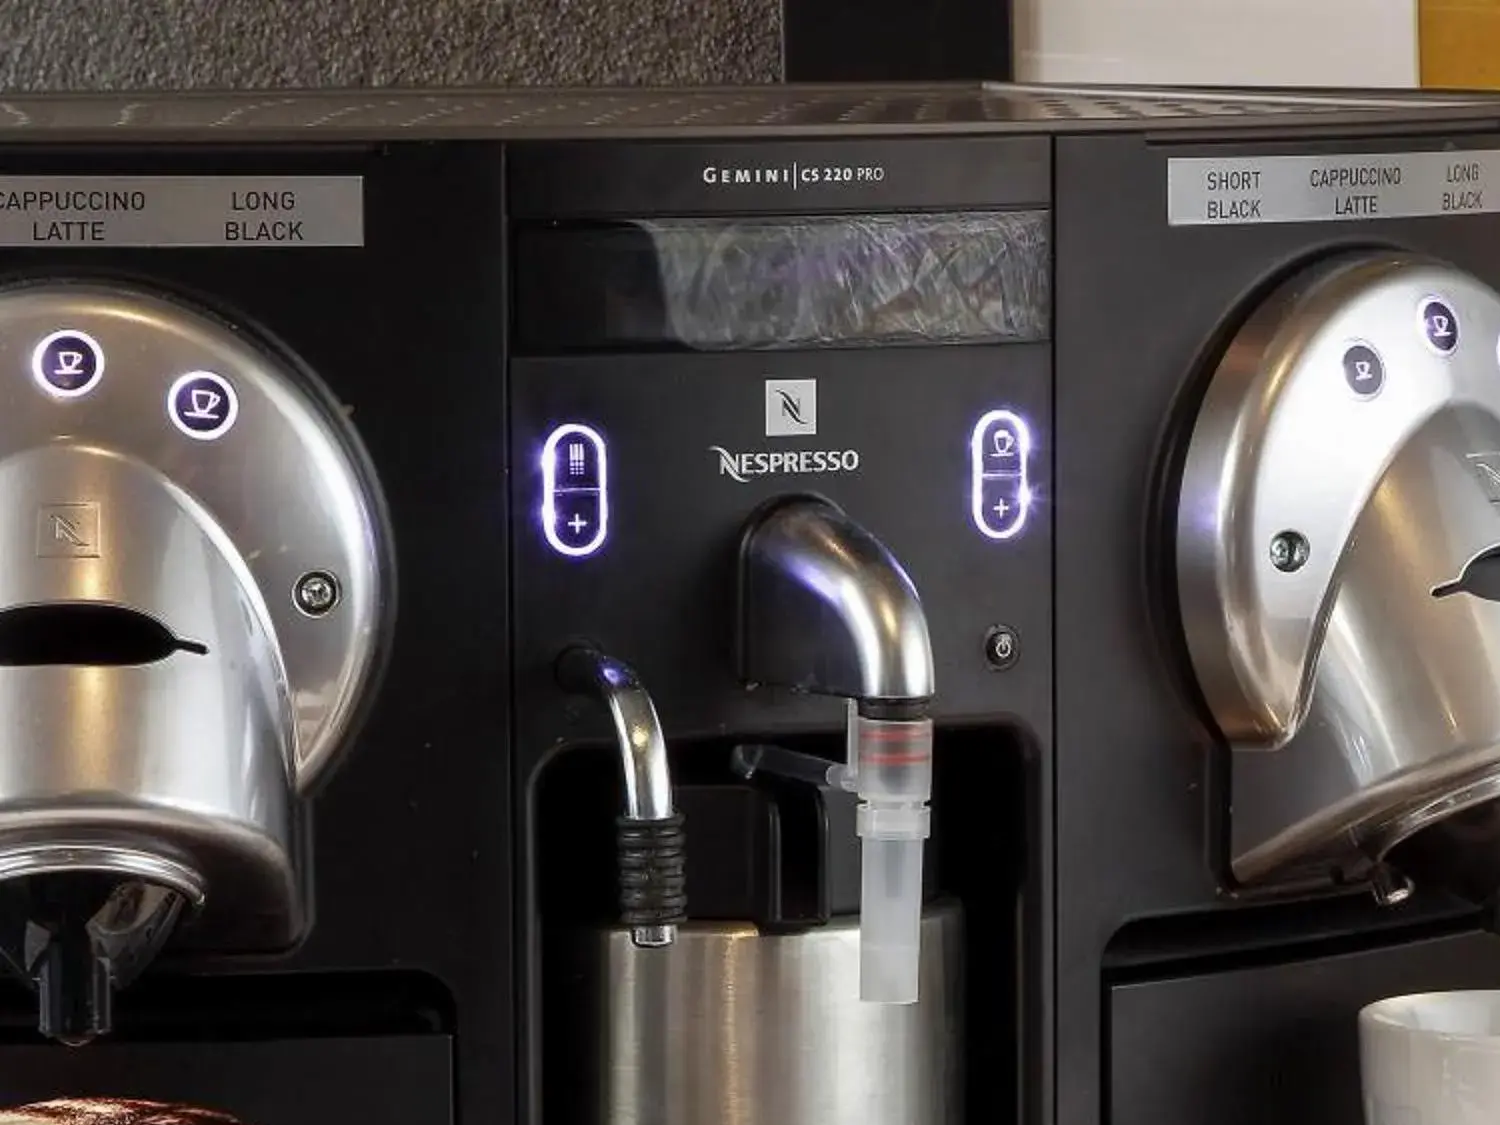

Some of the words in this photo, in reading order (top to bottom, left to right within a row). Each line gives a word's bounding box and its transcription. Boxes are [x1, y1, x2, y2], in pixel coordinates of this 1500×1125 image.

[703, 166, 790, 184] GEMINI
[801, 168, 819, 182] CS
[823, 167, 853, 182] 220
[857, 167, 885, 182] PRO
[1207, 171, 1262, 191] SHORT
[1310, 167, 1402, 187] CAPPUCCINO
[1446, 163, 1479, 182] LONG
[231, 191, 296, 211] LONG
[1207, 199, 1262, 220] BLACK
[1335, 195, 1378, 215] LATTE
[1442, 191, 1483, 211] BLACK
[33, 221, 105, 241] LATTE
[225, 221, 304, 241] BLACK
[707, 445, 860, 483] NESPRESSO
